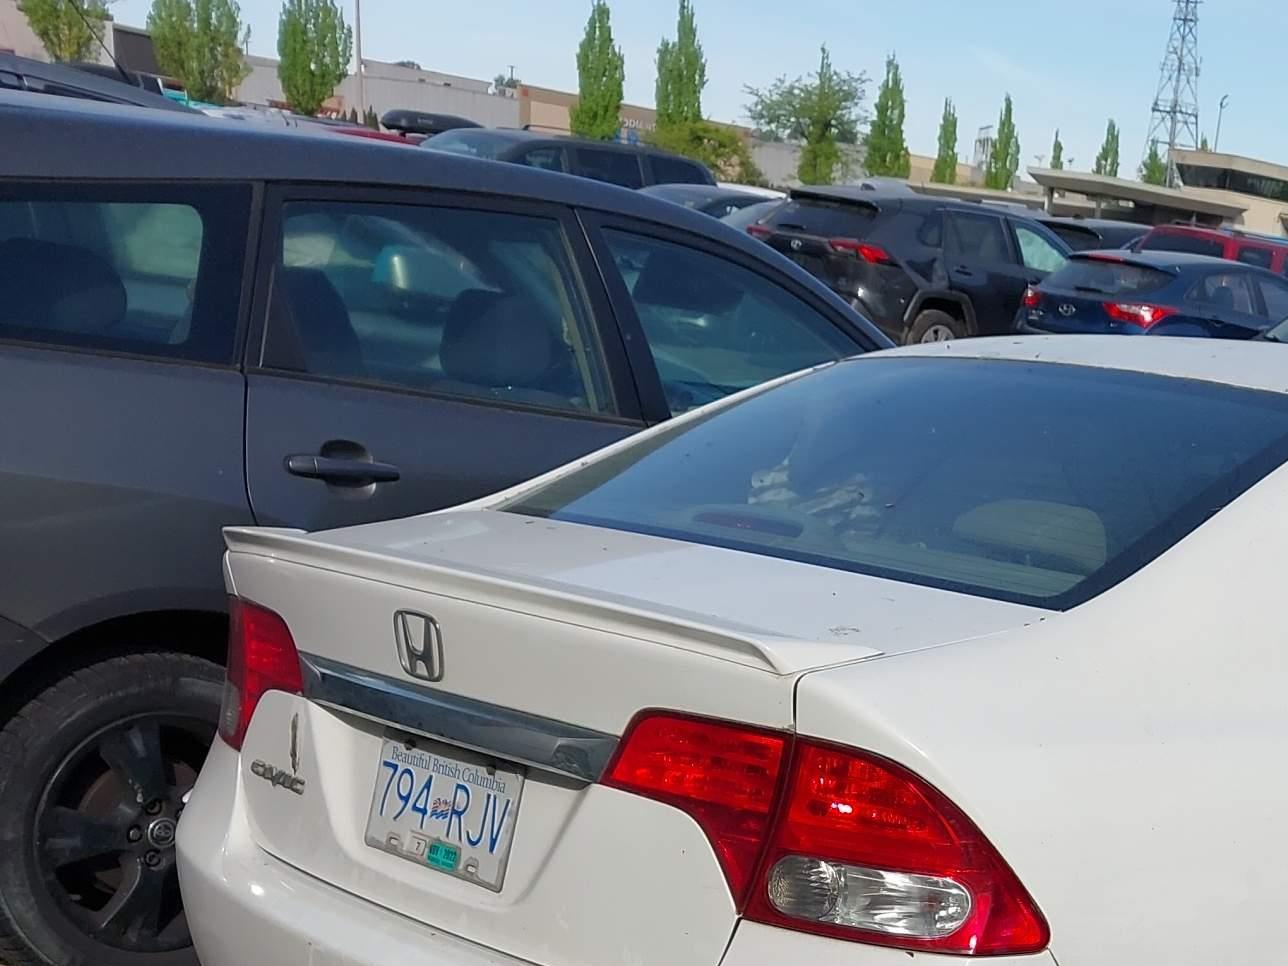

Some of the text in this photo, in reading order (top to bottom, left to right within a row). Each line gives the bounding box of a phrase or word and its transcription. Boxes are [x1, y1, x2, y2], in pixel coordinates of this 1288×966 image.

[391, 746, 506, 793] Beautiful British Columbia
[379, 760, 511, 855] 794 RJV
